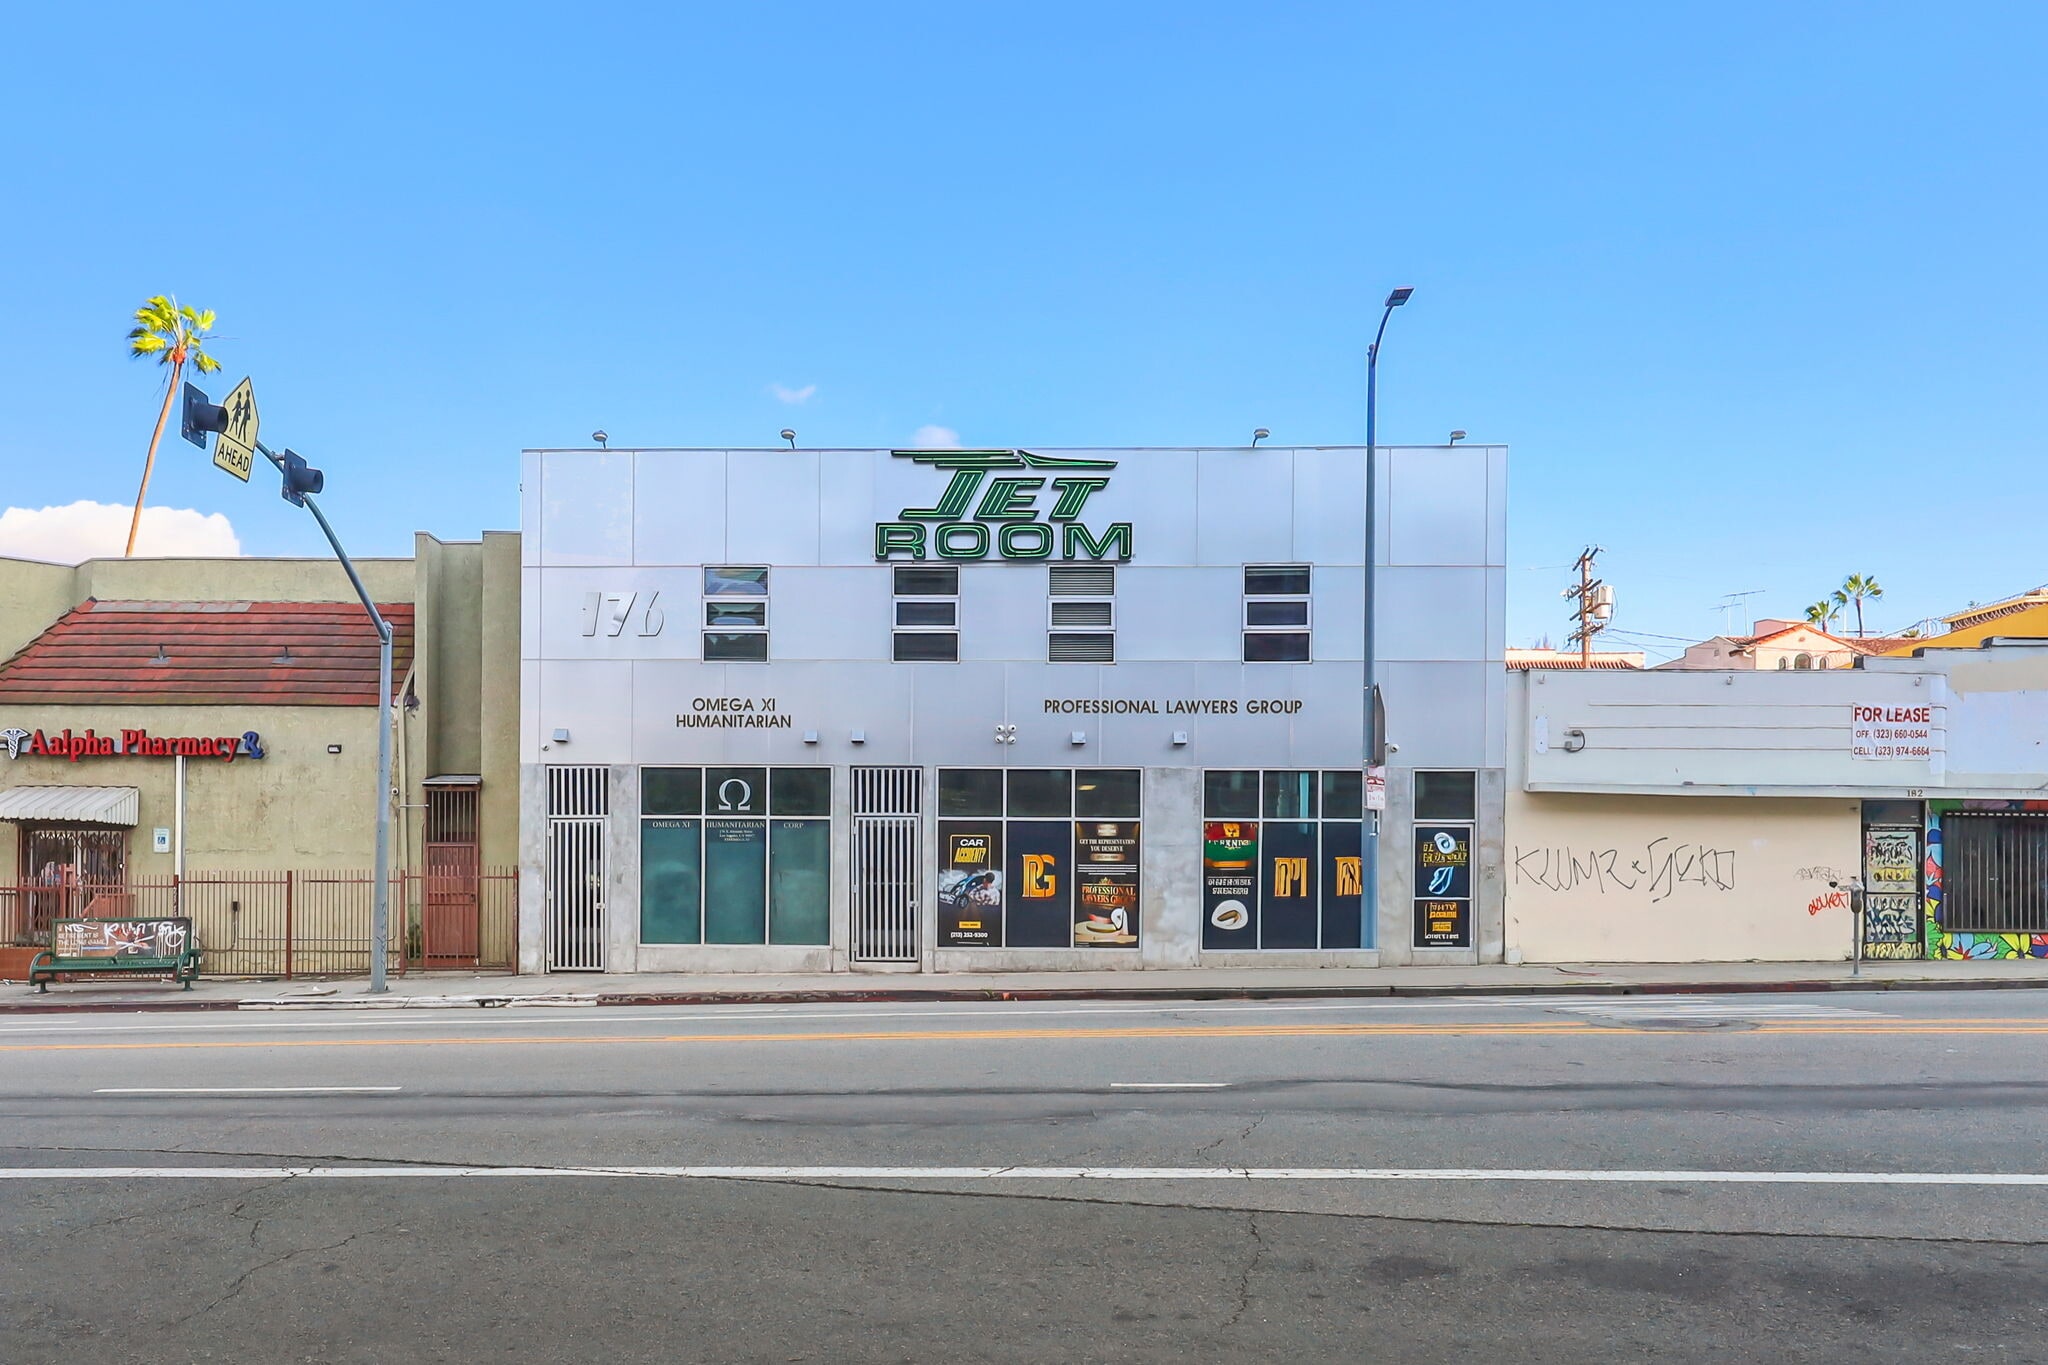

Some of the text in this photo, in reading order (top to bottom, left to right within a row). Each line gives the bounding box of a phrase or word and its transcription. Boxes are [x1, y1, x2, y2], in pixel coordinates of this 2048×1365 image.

[217, 442, 250, 472] AHEAD
[874, 522, 1133, 560] ROOM
[578, 590, 664, 637] 176
[692, 697, 776, 712] OMEGA XI
[1044, 699, 1303, 714] PROFESSIONAL LAWYERS GROUP
[676, 713, 792, 729] HUMANITARIAN
[1854, 707, 1930, 722] FOR LEASE
[1873, 728, 1893, 740] (323)
[28, 728, 115, 762] Aalpha
[120, 728, 240, 762] Pharmacy
[1874, 746, 1894, 758] (323)
[1907, 789, 1924, 797] 182
[960, 838, 984, 846] CAR
